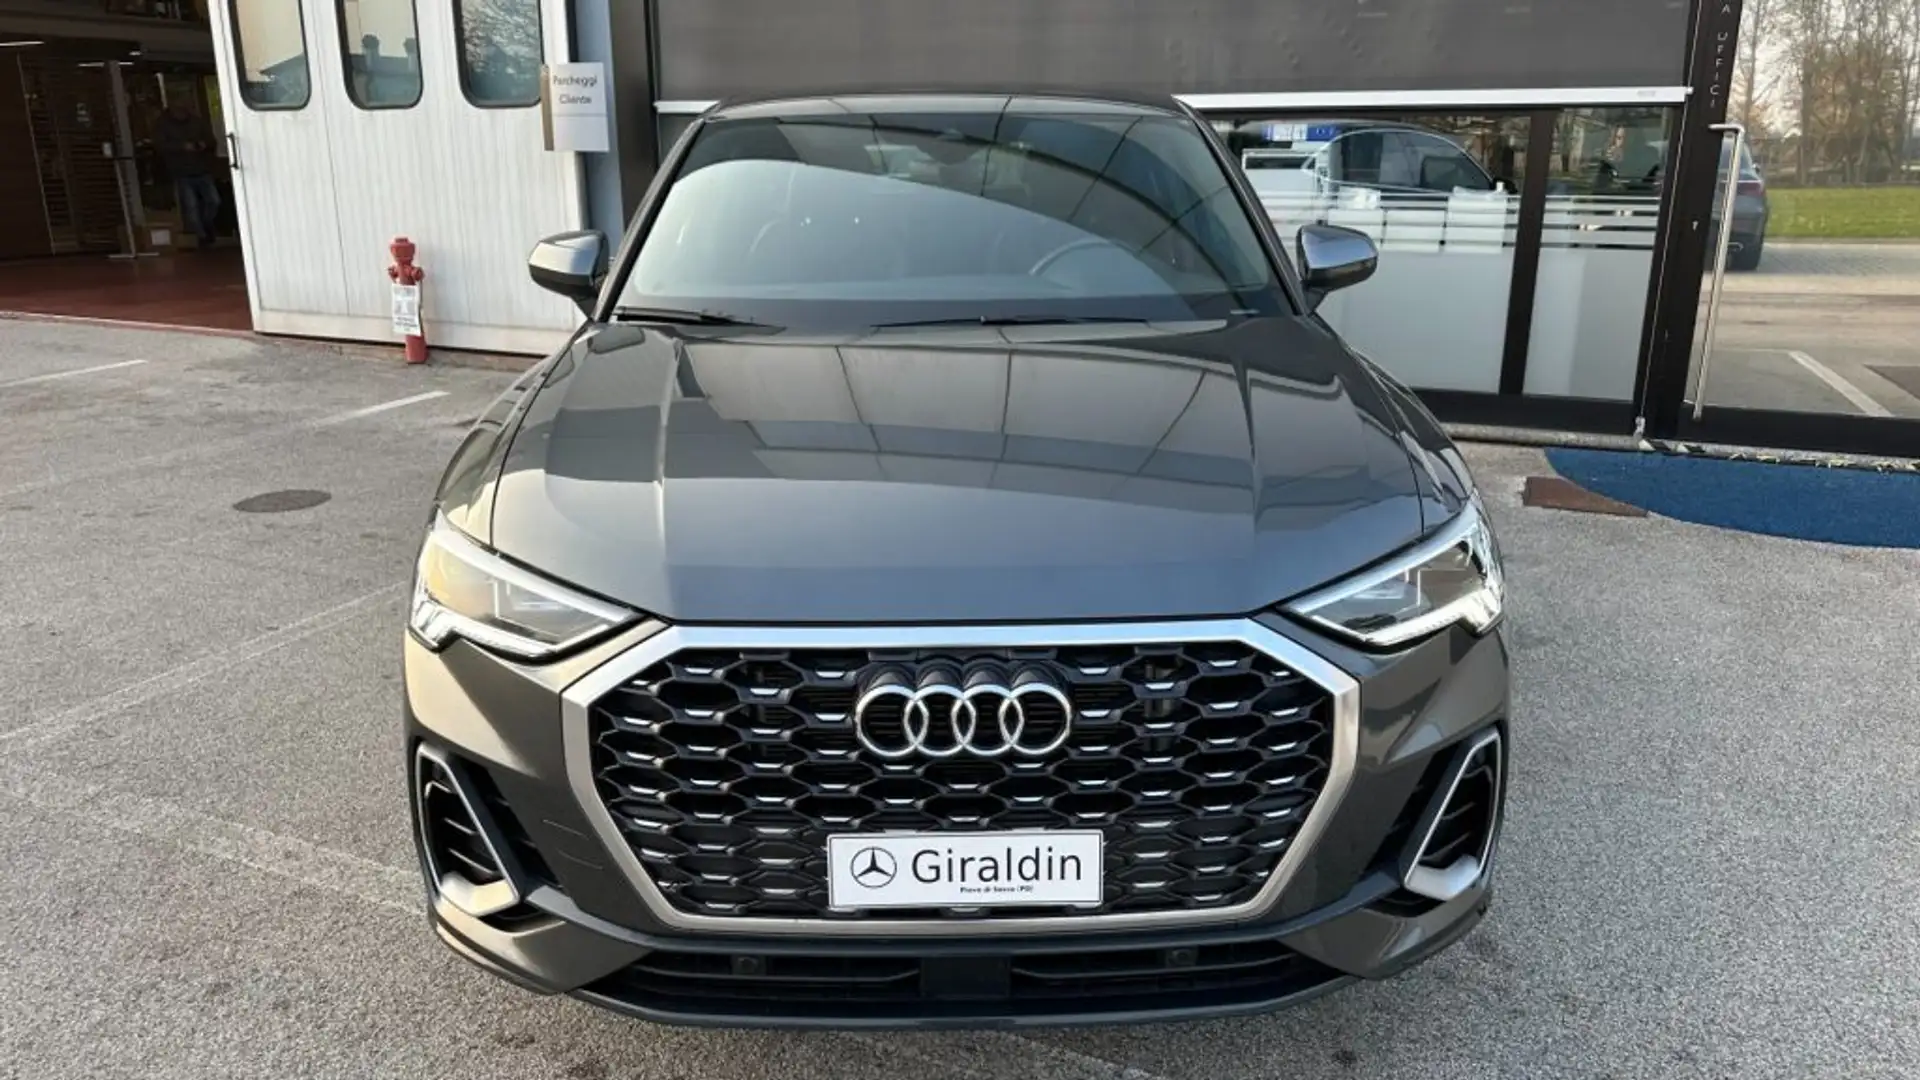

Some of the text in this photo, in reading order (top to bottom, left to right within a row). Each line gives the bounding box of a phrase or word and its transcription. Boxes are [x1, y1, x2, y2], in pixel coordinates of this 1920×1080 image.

[553, 75, 597, 88] Parcheggi
[1710, 31, 1728, 108] UFFICI
[911, 846, 1082, 883] Giraldin
